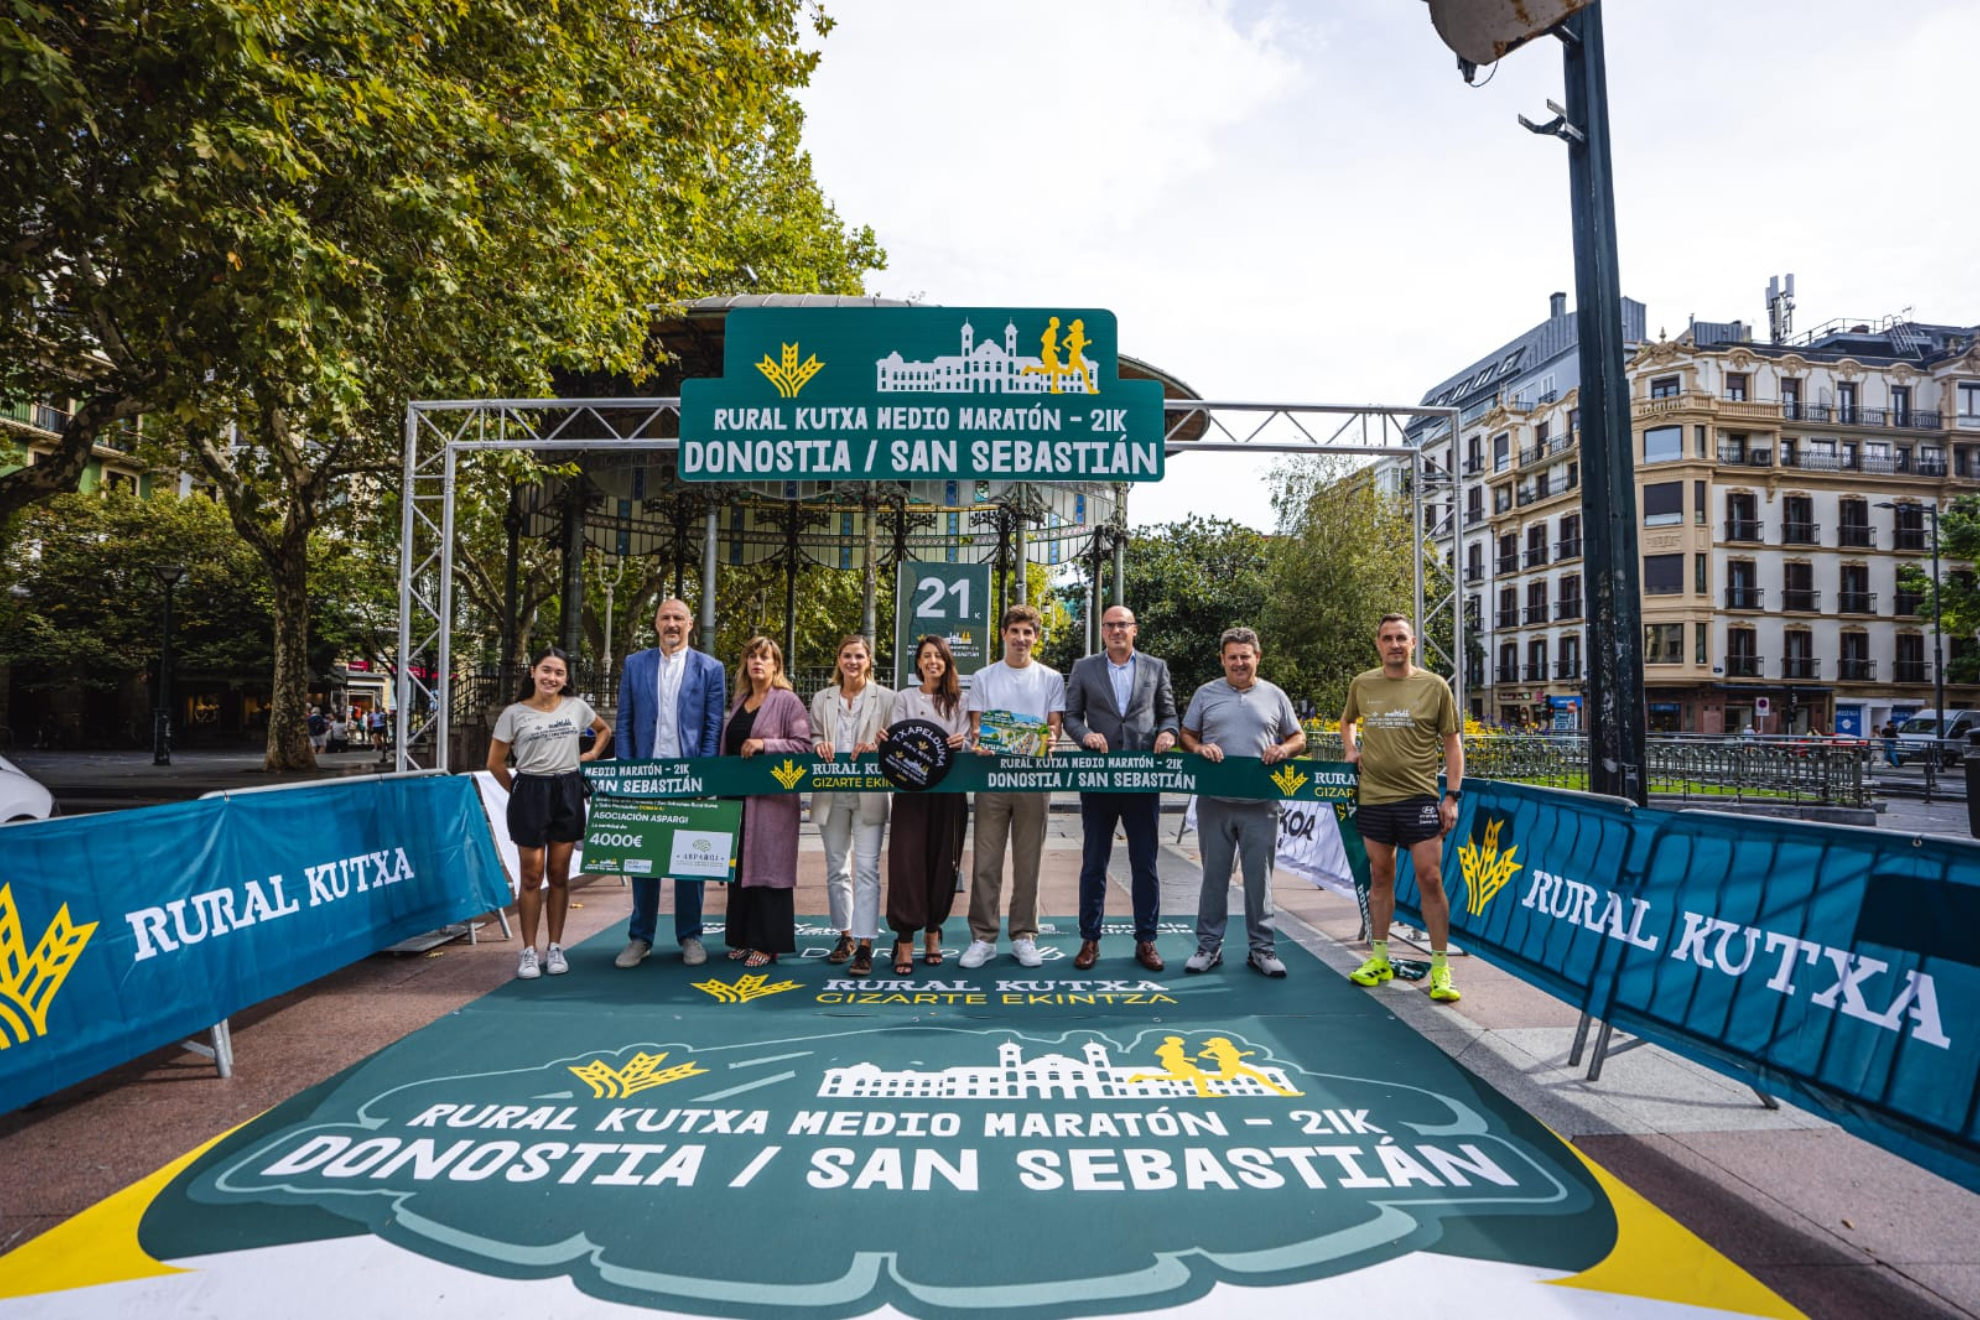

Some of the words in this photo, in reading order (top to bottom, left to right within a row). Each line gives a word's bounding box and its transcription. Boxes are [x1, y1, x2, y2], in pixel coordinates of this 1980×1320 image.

[714, 408, 787, 431] RURAL
[796, 408, 867, 430] KUTXA
[877, 407, 949, 430] MEDIO
[959, 403, 1061, 431] MARATÓN
[1091, 409, 1128, 433] 21K
[685, 440, 852, 473] DONOSTIA
[864, 440, 878, 472] /
[891, 440, 958, 473] SAN
[972, 434, 1157, 475] SEBASTIÁN
[916, 577, 970, 618] 21
[585, 766, 616, 777] MEDIO
[619, 762, 663, 777] MARATÓN
[812, 763, 860, 775] RURAL
[1000, 758, 1033, 769] RURAL
[1035, 757, 1068, 769] KUTXA
[1072, 757, 1105, 768] MEDIO
[1108, 755, 1154, 769] MARATÓN
[623, 776, 703, 793] SEBASTIÁN
[812, 777, 862, 788] GIZARTE
[988, 772, 1061, 788] DONOSTIA
[1078, 772, 1109, 787] SAN
[1113, 770, 1196, 790] SEBASTIÁN
[593, 811, 649, 822] ASOCIACIÓN
[651, 814, 689, 824] ASPARGI
[589, 832, 643, 848] 4000€
[125, 874, 300, 962] RURAL
[304, 848, 414, 907] KUTXA
[1522, 869, 1659, 952] RURAL
[1671, 910, 1951, 1050] KUTXA
[822, 979, 980, 991] RURAL
[995, 980, 1170, 992] KUTXA
[815, 993, 988, 1005] GIZARTE
[1002, 993, 1179, 1005] EKINTZA
[406, 1103, 577, 1131] RURAL
[595, 1108, 769, 1135] KUTXA
[788, 1110, 960, 1137] MEDIO
[984, 1106, 1222, 1138] MARATÓN
[1288, 1109, 1388, 1135] 21K
[261, 1135, 705, 1187] DONOSTIA
[805, 1147, 980, 1191] SAN
[1017, 1136, 1519, 1192] SEBASTIÁN
